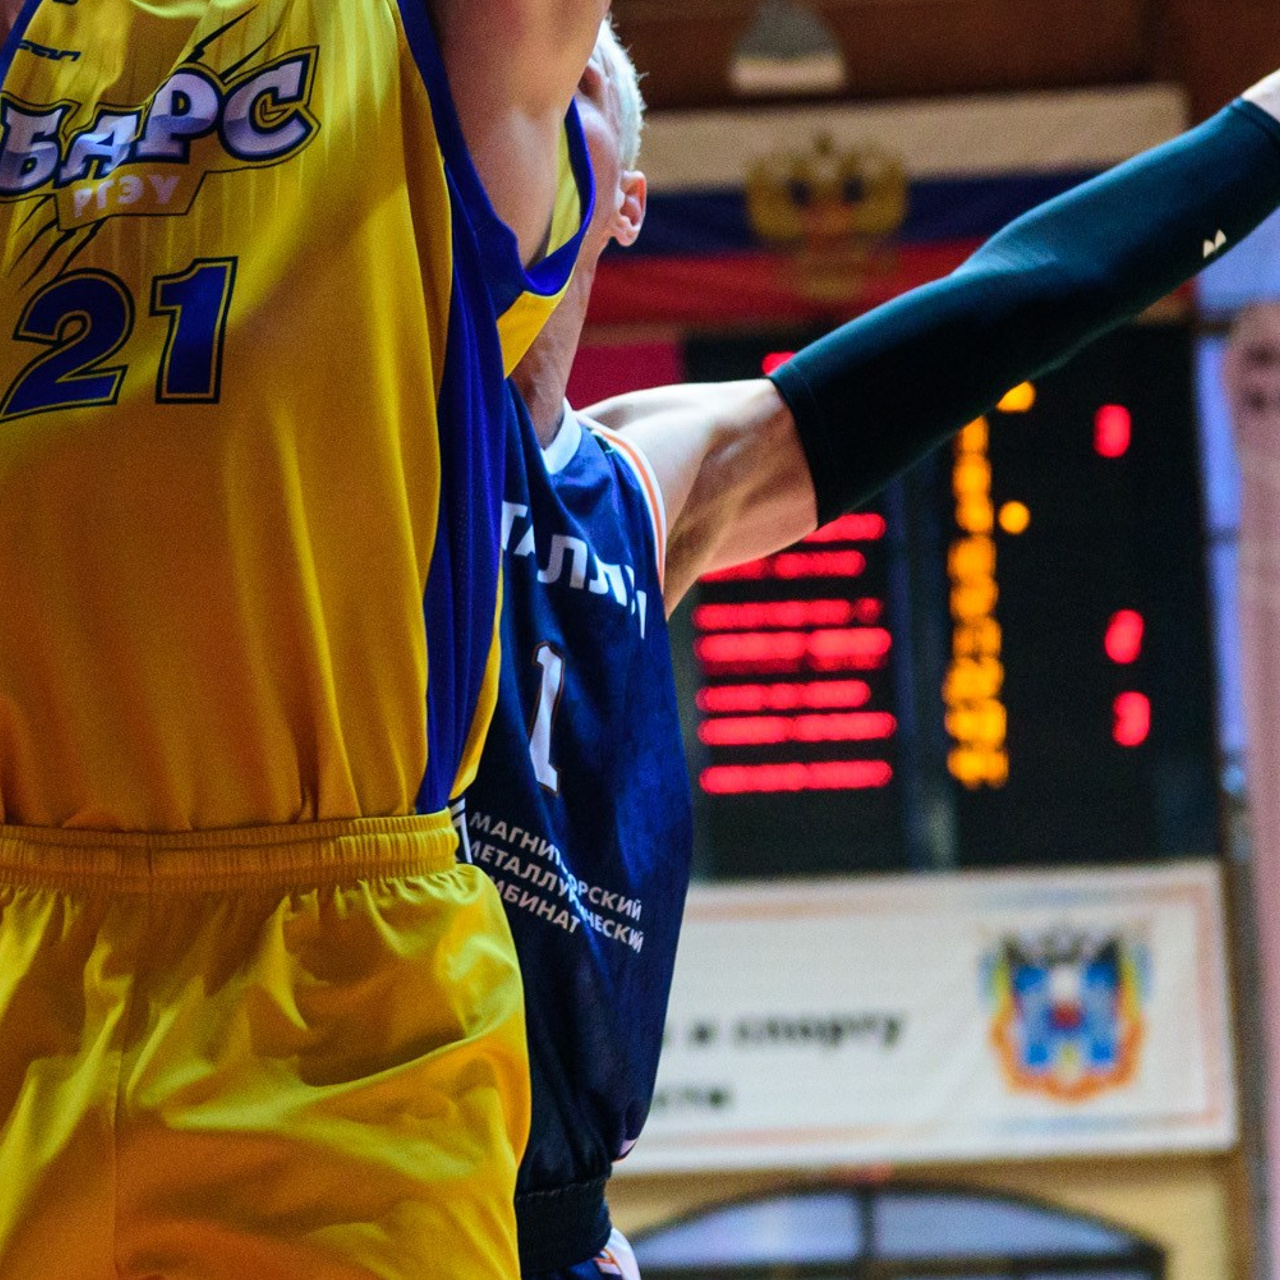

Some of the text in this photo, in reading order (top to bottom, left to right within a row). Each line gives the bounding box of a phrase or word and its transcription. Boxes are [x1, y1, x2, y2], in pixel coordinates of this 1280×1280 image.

[72, 173, 181, 219] РГЭУ
[469, 811, 642, 921] МАГНИОРСКИЙ
[489, 875, 580, 934] БИНАТ
